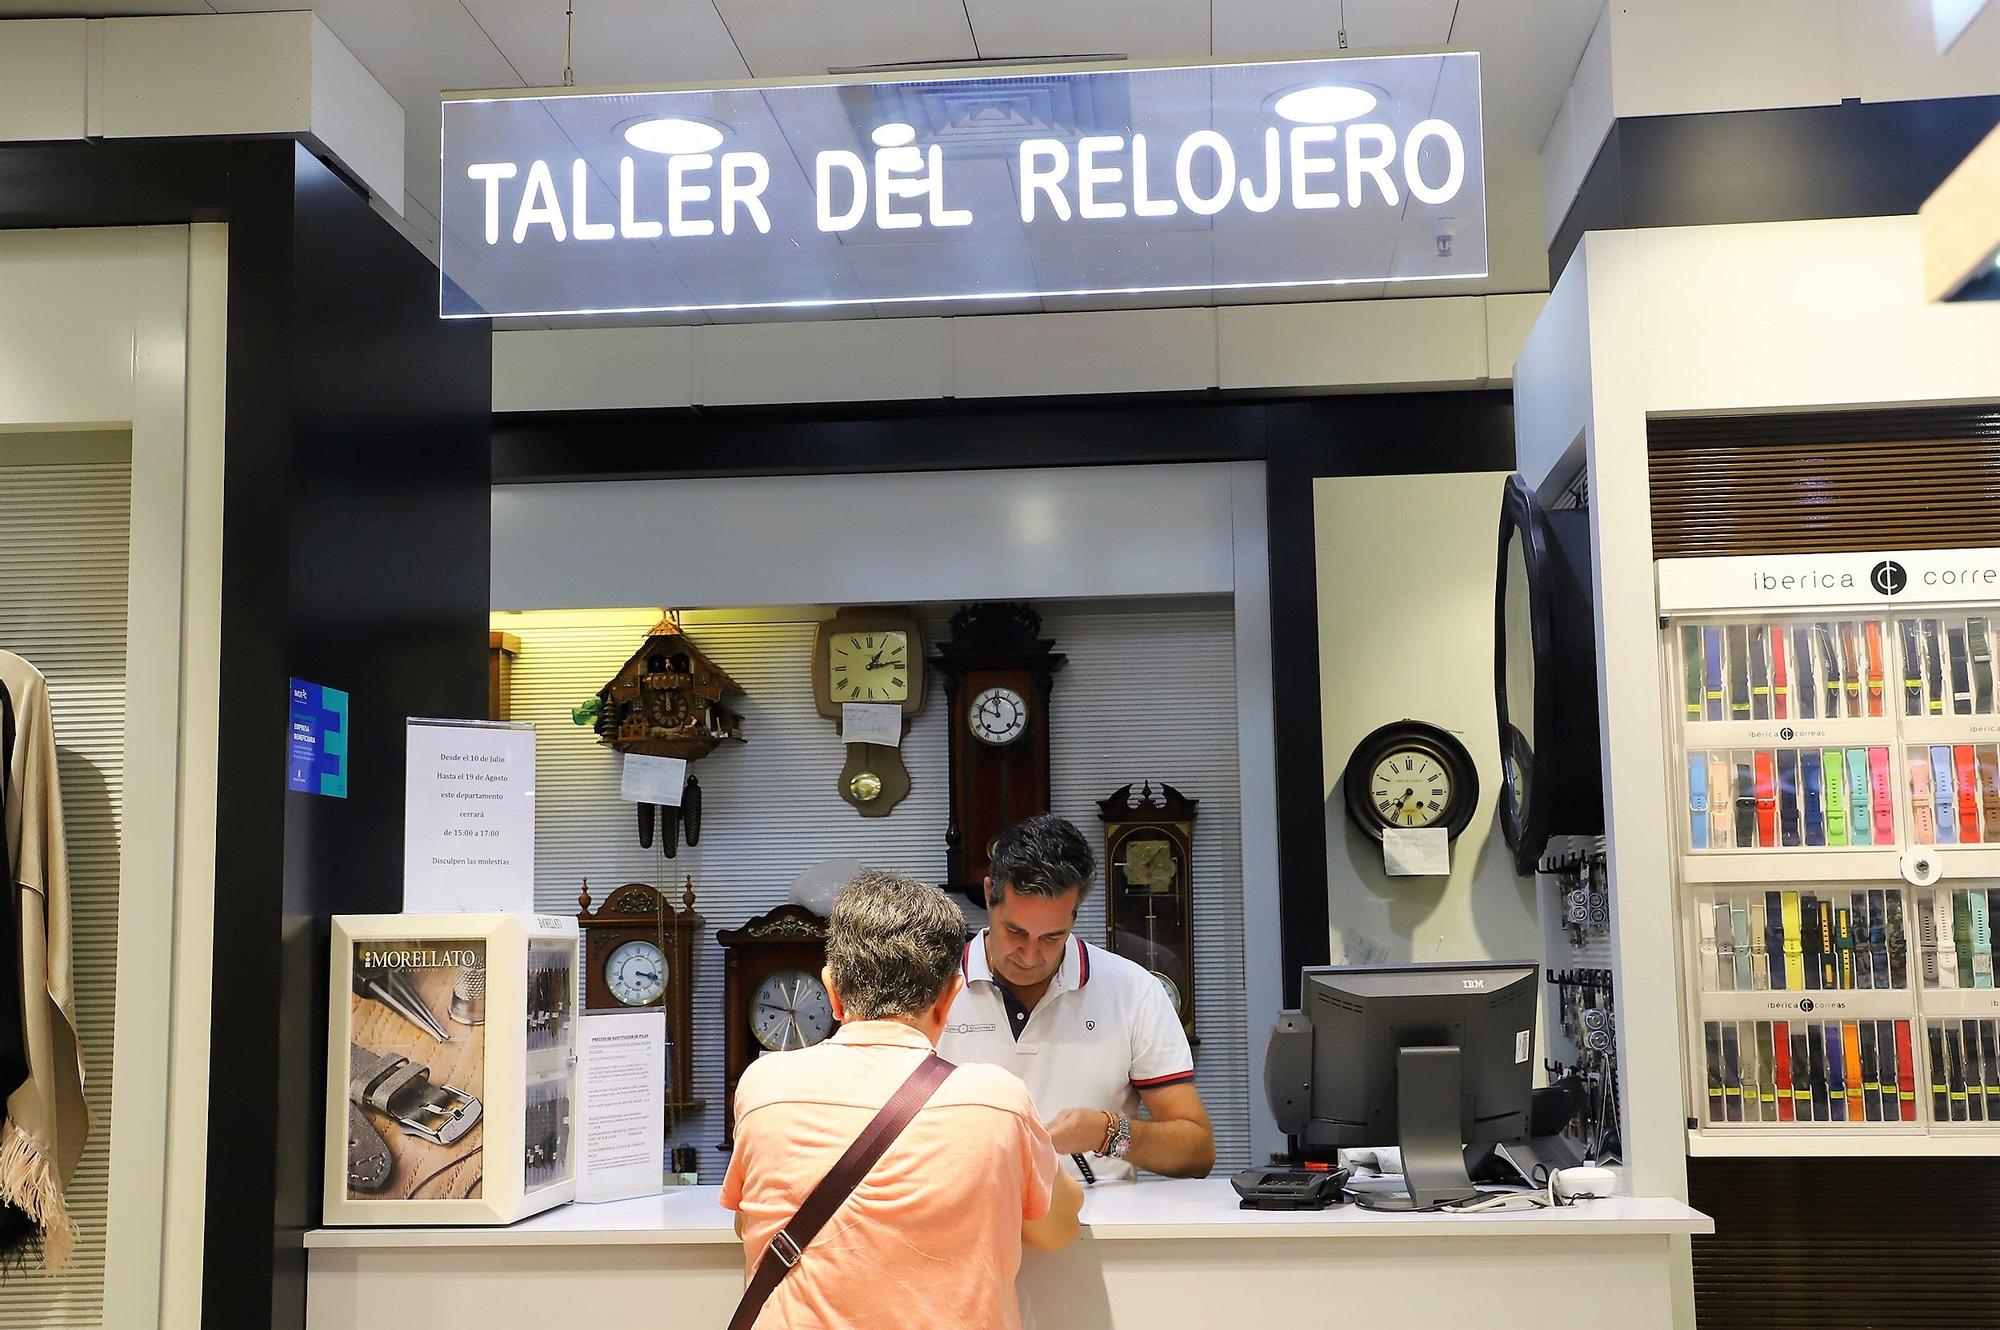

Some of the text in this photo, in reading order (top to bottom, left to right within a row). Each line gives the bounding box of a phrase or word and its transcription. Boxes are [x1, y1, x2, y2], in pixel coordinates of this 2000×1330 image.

[467, 118, 1465, 246] TALLER DEL RELOJERO
[1753, 569, 1998, 590] iberica corre
[440, 753, 461, 761] Desde
[436, 772, 456, 780] Hasta
[485, 774, 508, 782] Agosto
[456, 791, 504, 800] departamento
[454, 829, 473, 837] 15:00
[432, 857, 510, 866] Disculpen las molestias
[371, 949, 476, 968] MORELLATO
[1462, 979, 1485, 989] IBM
[1767, 1001, 1847, 1009] iberica correas
